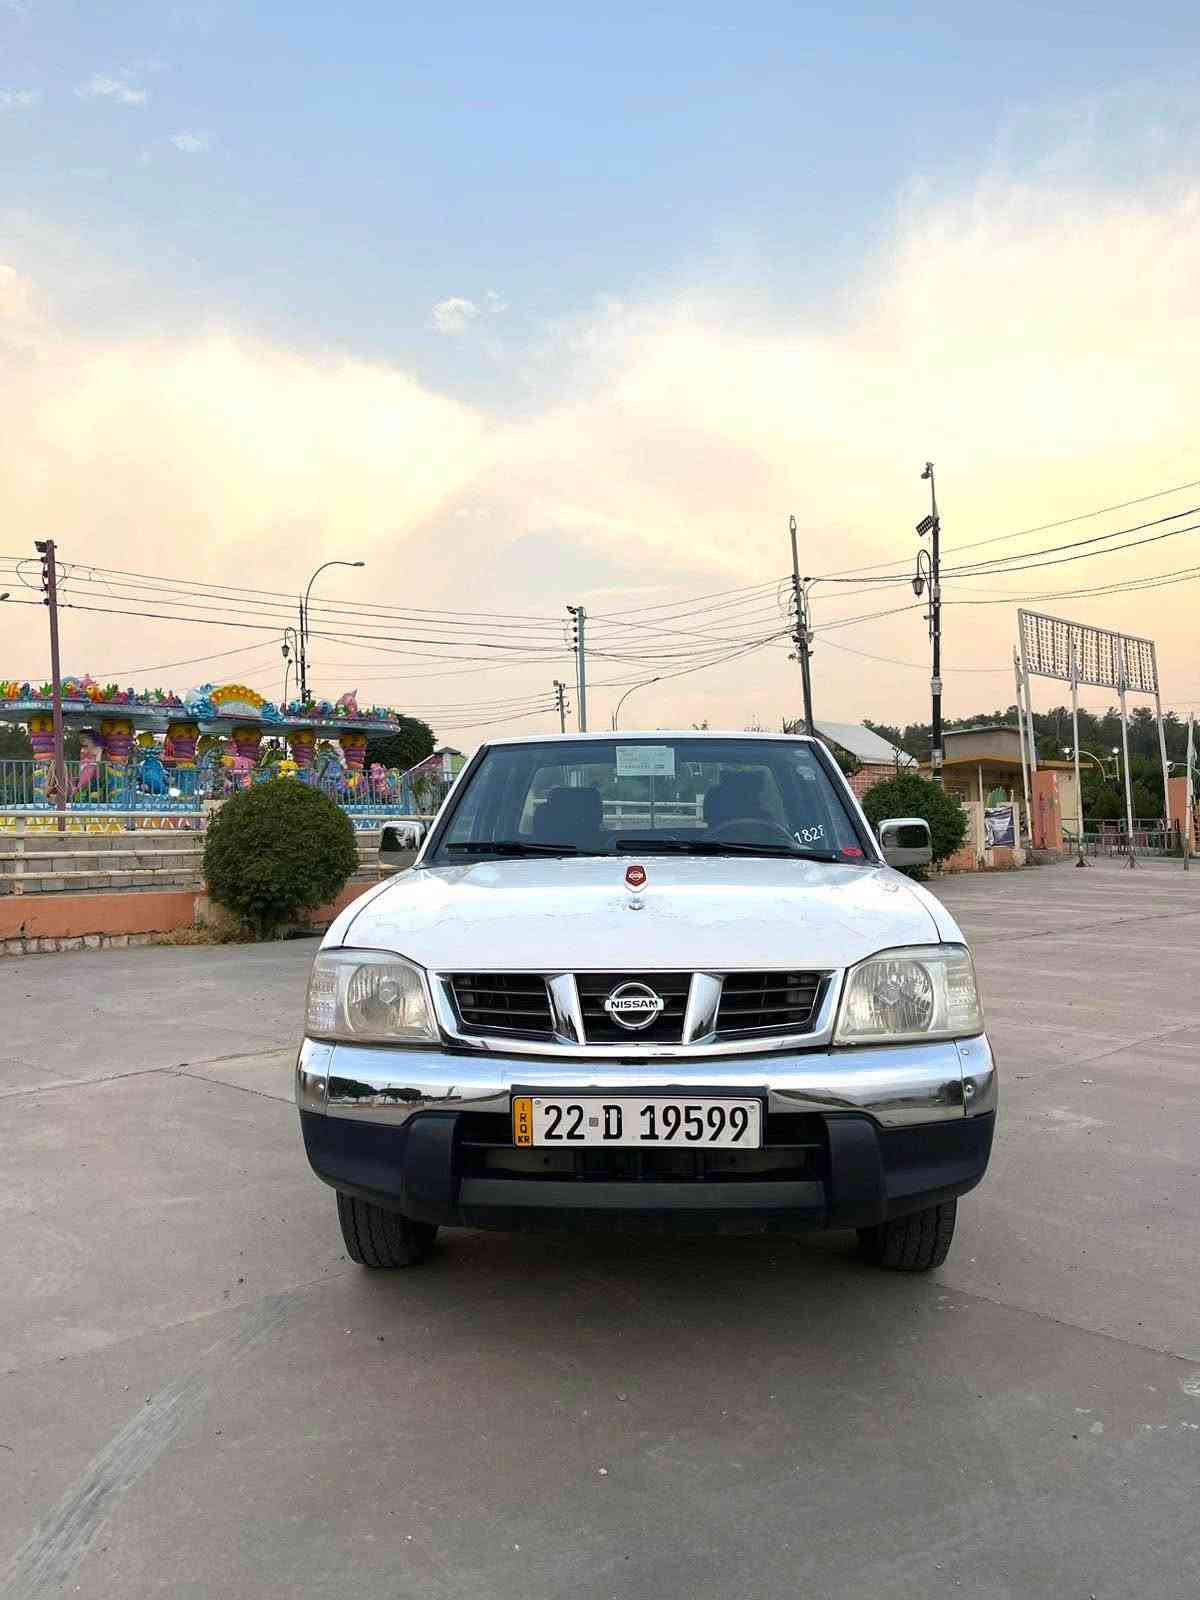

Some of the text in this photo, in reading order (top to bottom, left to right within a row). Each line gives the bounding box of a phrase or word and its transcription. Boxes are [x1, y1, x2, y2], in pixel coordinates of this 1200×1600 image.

[611, 999, 658, 1009] NISSAN
[544, 1104, 748, 1142] 22 D 19599
[517, 1135, 530, 1143] KR
